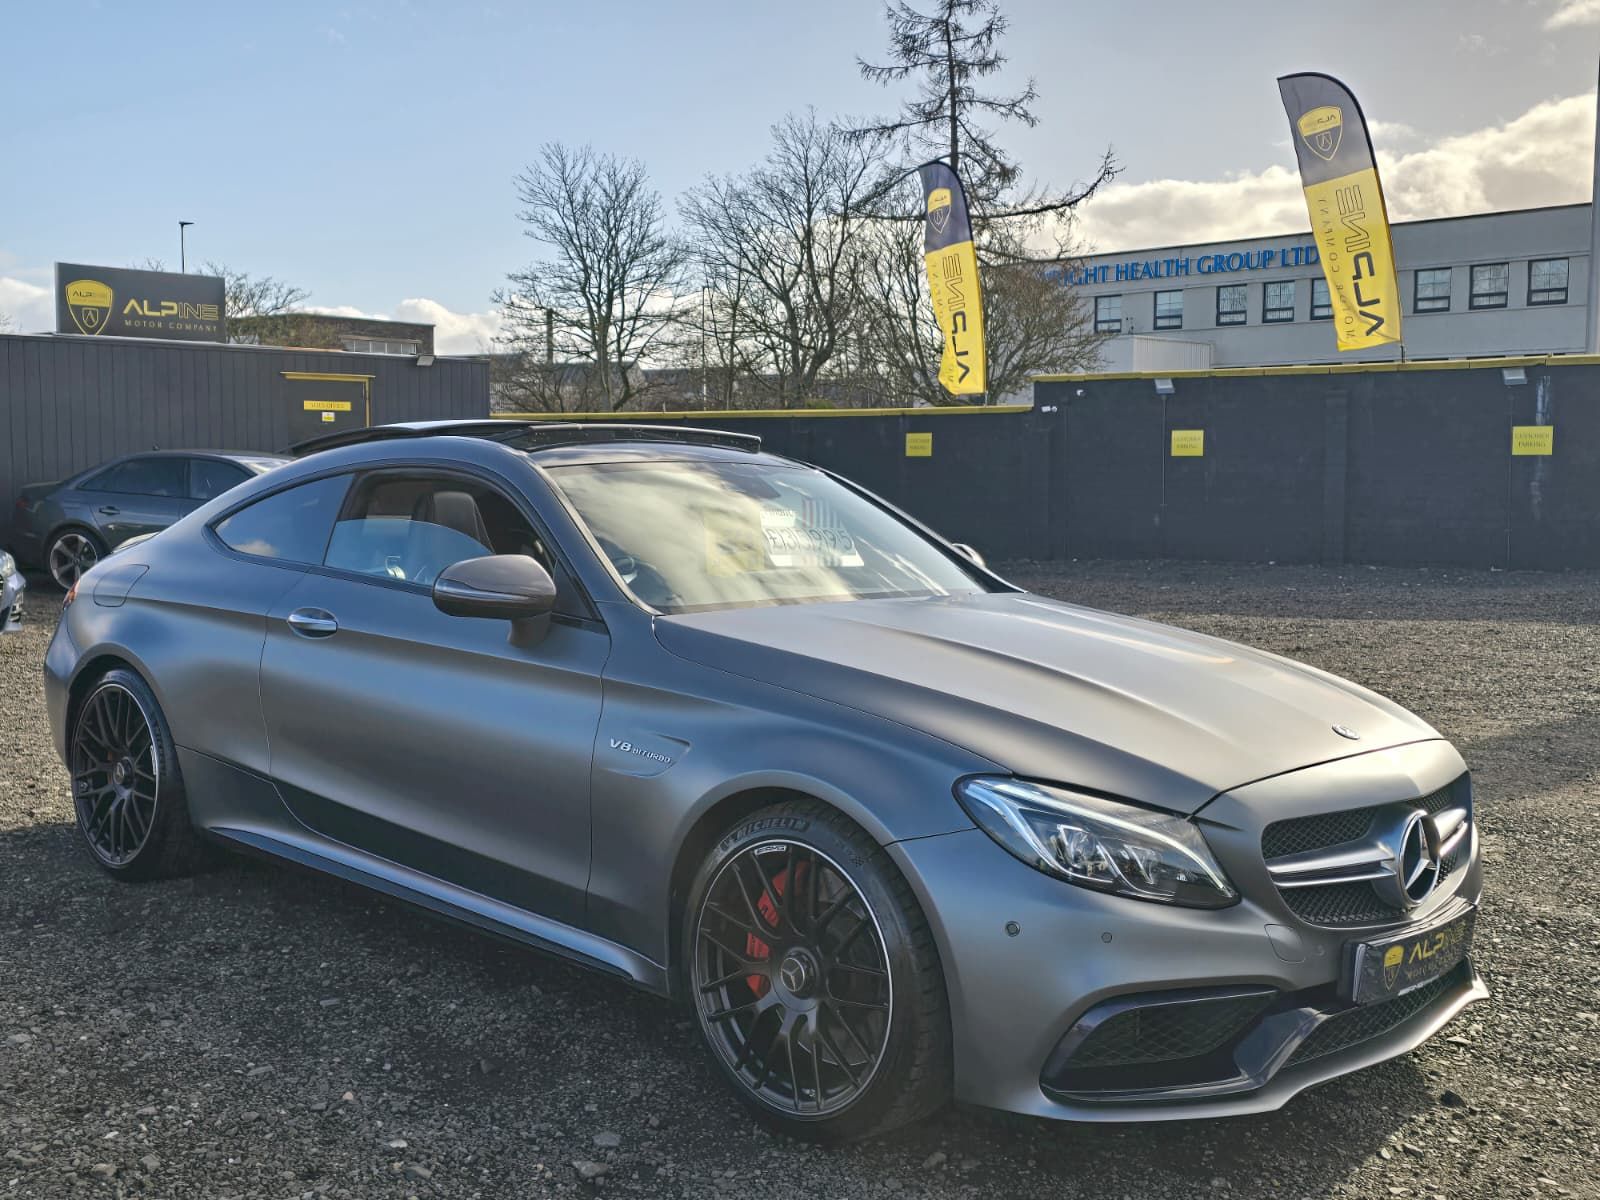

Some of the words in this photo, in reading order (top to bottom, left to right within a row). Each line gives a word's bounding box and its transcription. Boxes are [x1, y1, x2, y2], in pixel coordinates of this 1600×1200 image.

[1115, 257, 1190, 282] HEALTH
[1197, 249, 1274, 275] GROUP
[1281, 245, 1320, 268] LTD
[123, 298, 219, 321] ALPINE
[124, 319, 163, 329] MOTOR
[168, 321, 218, 333] COMPANY
[610, 738, 632, 752] V8
[632, 747, 672, 764] BITURBO
[736, 818, 811, 841] MICHELIN
